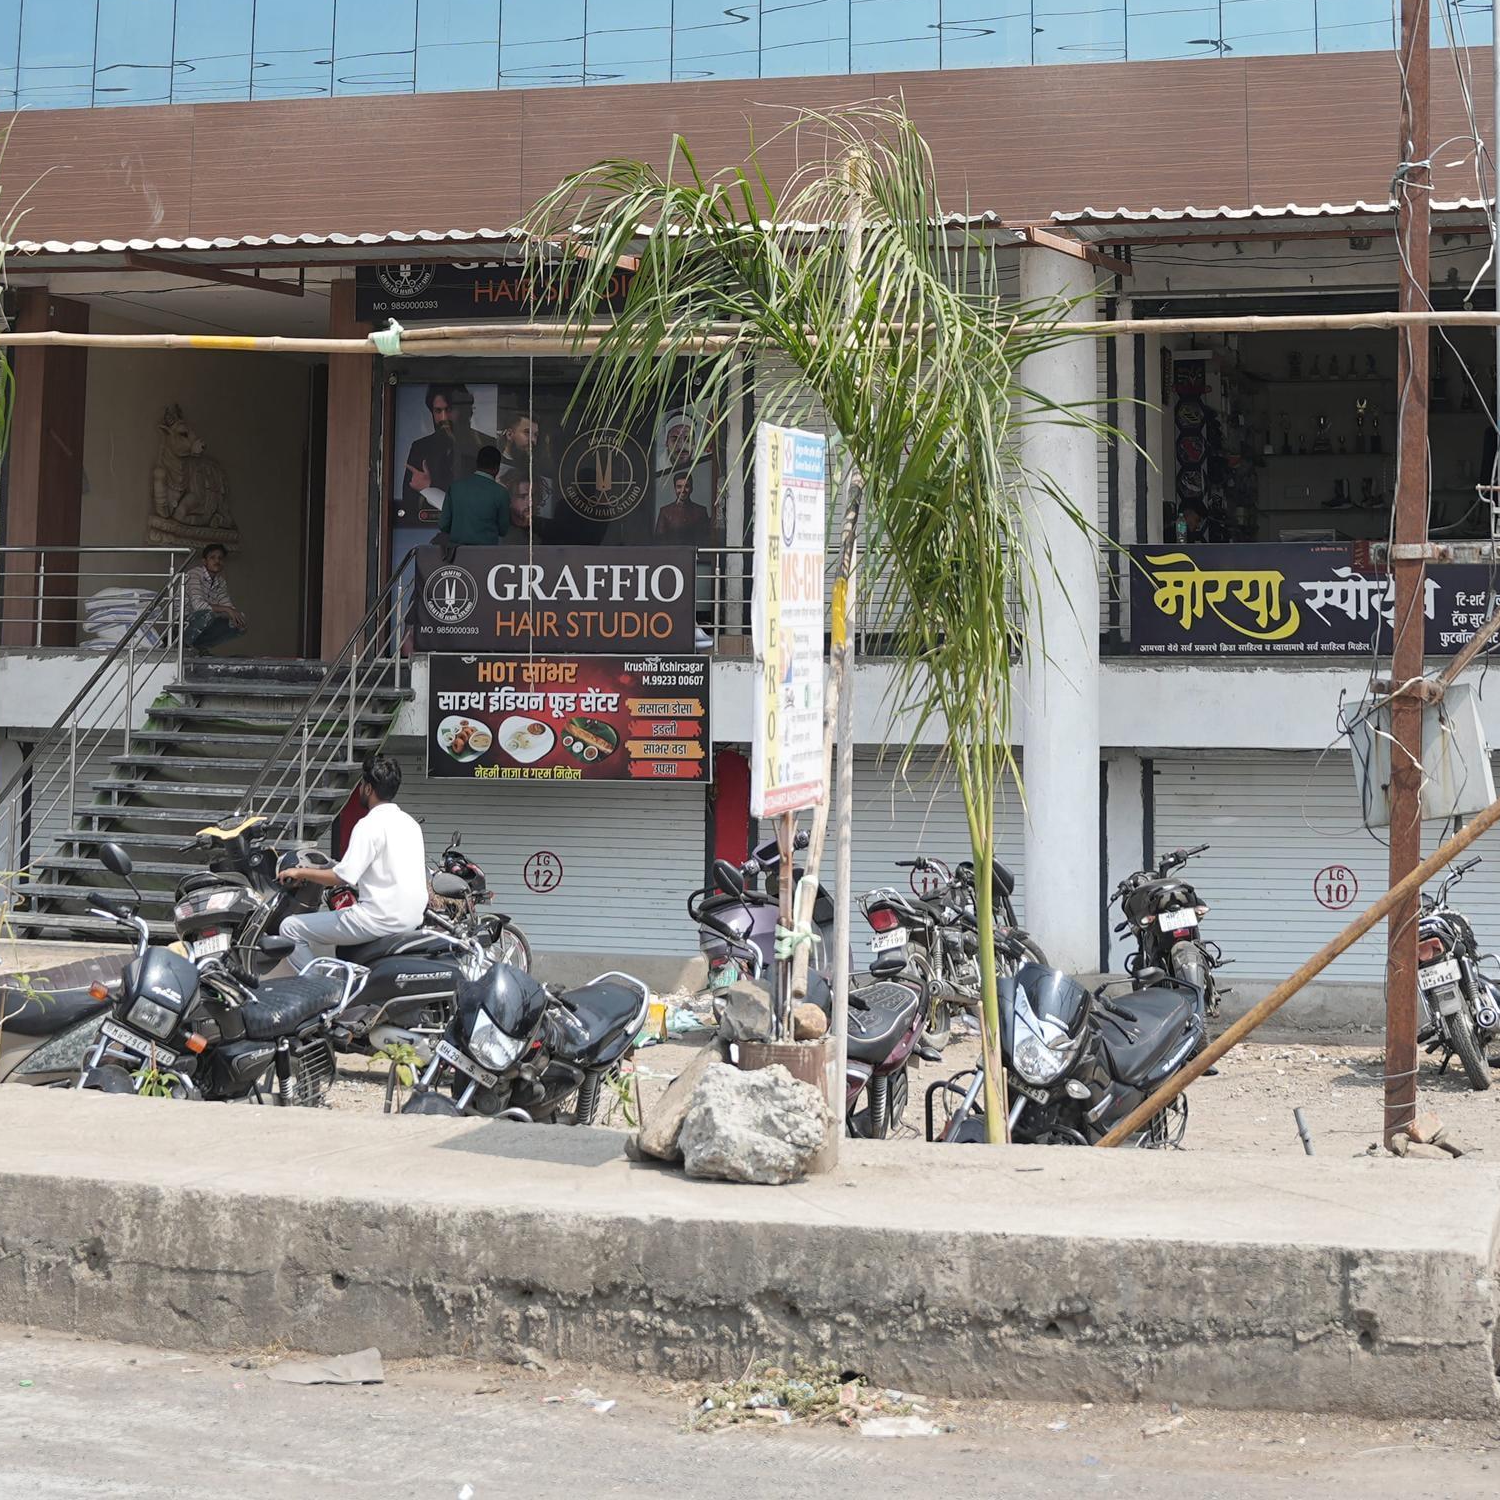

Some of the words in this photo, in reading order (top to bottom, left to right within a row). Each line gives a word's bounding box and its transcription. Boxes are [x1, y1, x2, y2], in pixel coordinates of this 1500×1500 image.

[373, 302, 389, 311] MO.
[391, 301, 438, 310] 9850000393
[487, 564, 685, 602] GRAFFIO
[781, 551, 824, 602] MS-CIT
[1144, 552, 1300, 640] मोरया
[1455, 591, 1486, 606] टि-शर्ट
[495, 611, 559, 637] HAIR
[566, 611, 674, 639] STUDIO
[1451, 610, 1468, 626] ट्रॅक
[1469, 613, 1486, 628] सुट
[420, 626, 435, 634] MO.
[436, 626, 480, 635] 9850000393
[1180, 642, 1192, 652] सर्व
[477, 662, 518, 683] HOT
[520, 658, 578, 684] सांभर
[624, 661, 658, 672] Krushna
[660, 662, 704, 674] Kshirsagar
[642, 675, 677, 686] M.99233
[678, 675, 704, 686] 00607
[437, 691, 486, 711] साउथ
[486, 686, 546, 713] इंडियन
[547, 691, 577, 718] फूड
[578, 687, 620, 712] सेंटर
[637, 703, 669, 714] मसाला
[670, 700, 693, 714] डोसा
[652, 720, 677, 736] इडली
[671, 743, 687, 755] वडा
[474, 764, 500, 779] नेहमी
[501, 767, 521, 779] ताजा
[531, 767, 552, 780] गरम
[553, 765, 582, 780] मिळेल
[652, 763, 677, 775] उपमा
[536, 855, 551, 866] LG
[534, 869, 553, 887] 12
[1329, 869, 1345, 881] LG
[1325, 883, 1348, 903] 10
